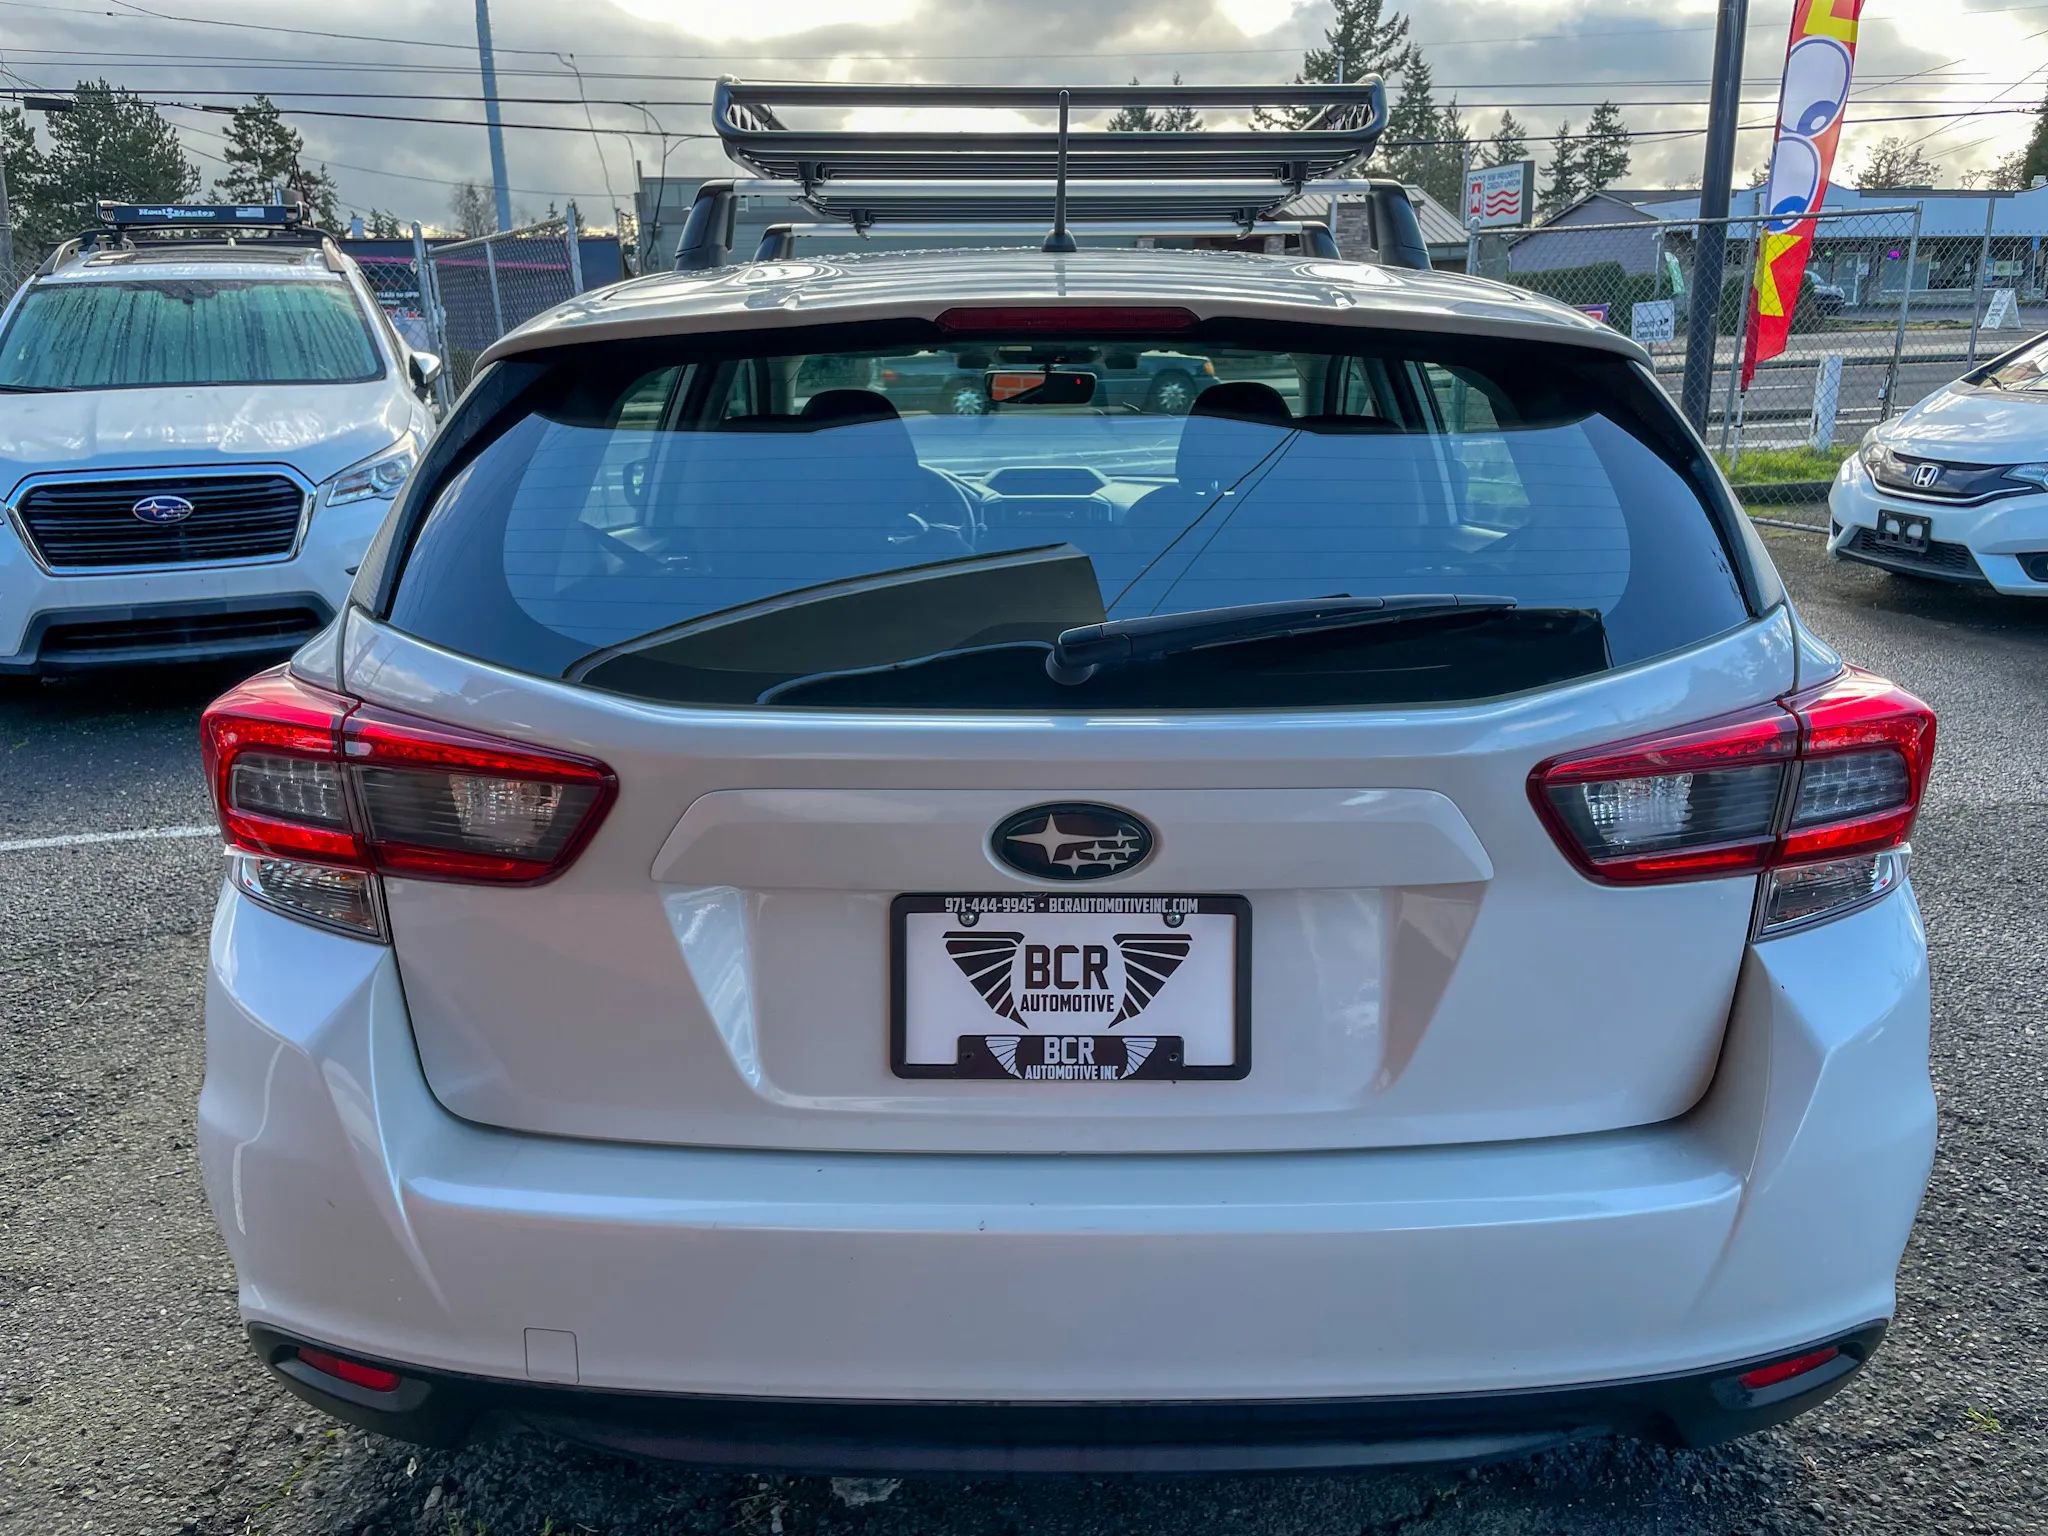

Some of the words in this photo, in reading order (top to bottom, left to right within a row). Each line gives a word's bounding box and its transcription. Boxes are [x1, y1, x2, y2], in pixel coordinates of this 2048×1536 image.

[945, 897, 1036, 913] 971-444-9945
[1048, 897, 1199, 914] BCRAUTOMOTIVEINC.COM
[1025, 944, 1109, 990] BCR
[1020, 994, 1115, 1013] AUTOMOTIVE
[1043, 1036, 1095, 1065] BCR
[1024, 1065, 1099, 1080] AUTOMOTIVE
[1100, 1065, 1119, 1080] INC
